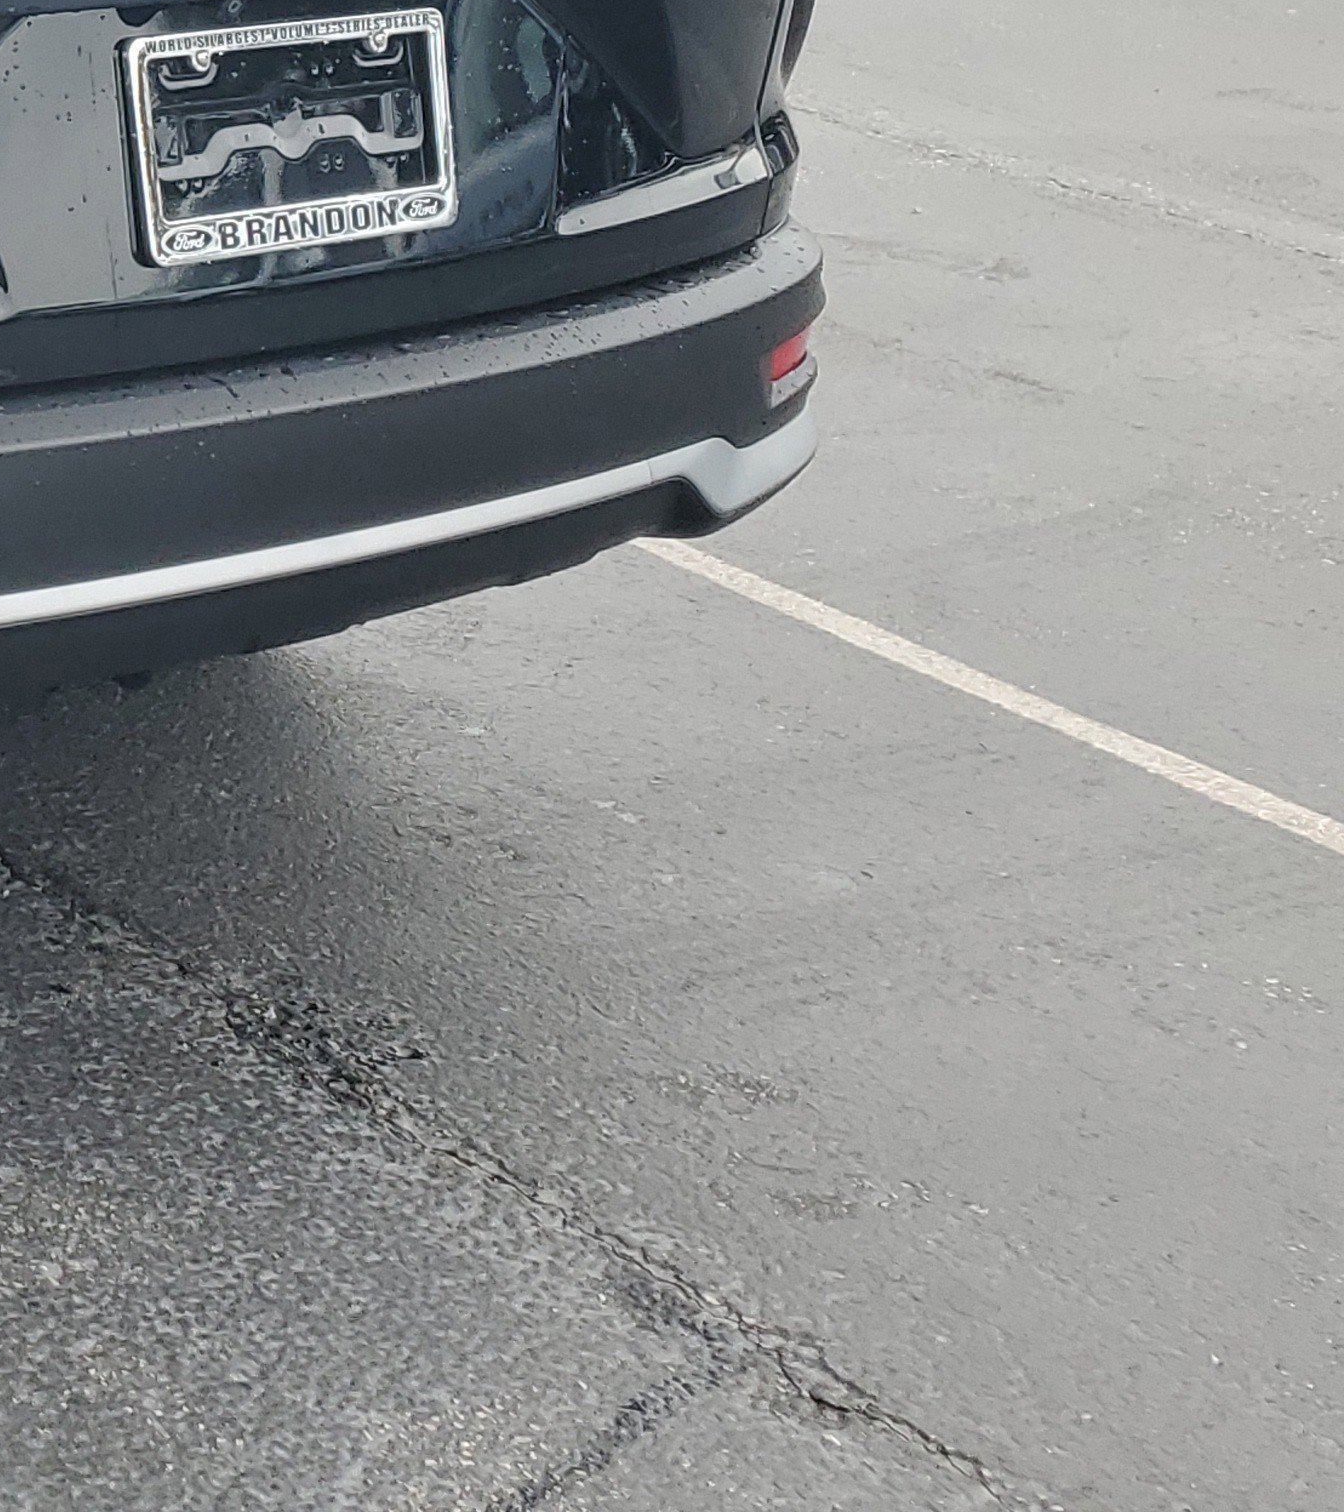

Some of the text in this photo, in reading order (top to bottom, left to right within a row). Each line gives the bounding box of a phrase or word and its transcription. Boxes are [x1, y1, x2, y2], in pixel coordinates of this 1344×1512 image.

[211, 29, 266, 47] LARGEST
[271, 22, 320, 40] VOLUME
[385, 14, 430, 29] DEALER
[172, 197, 440, 252] Ford BRANDON Ford
